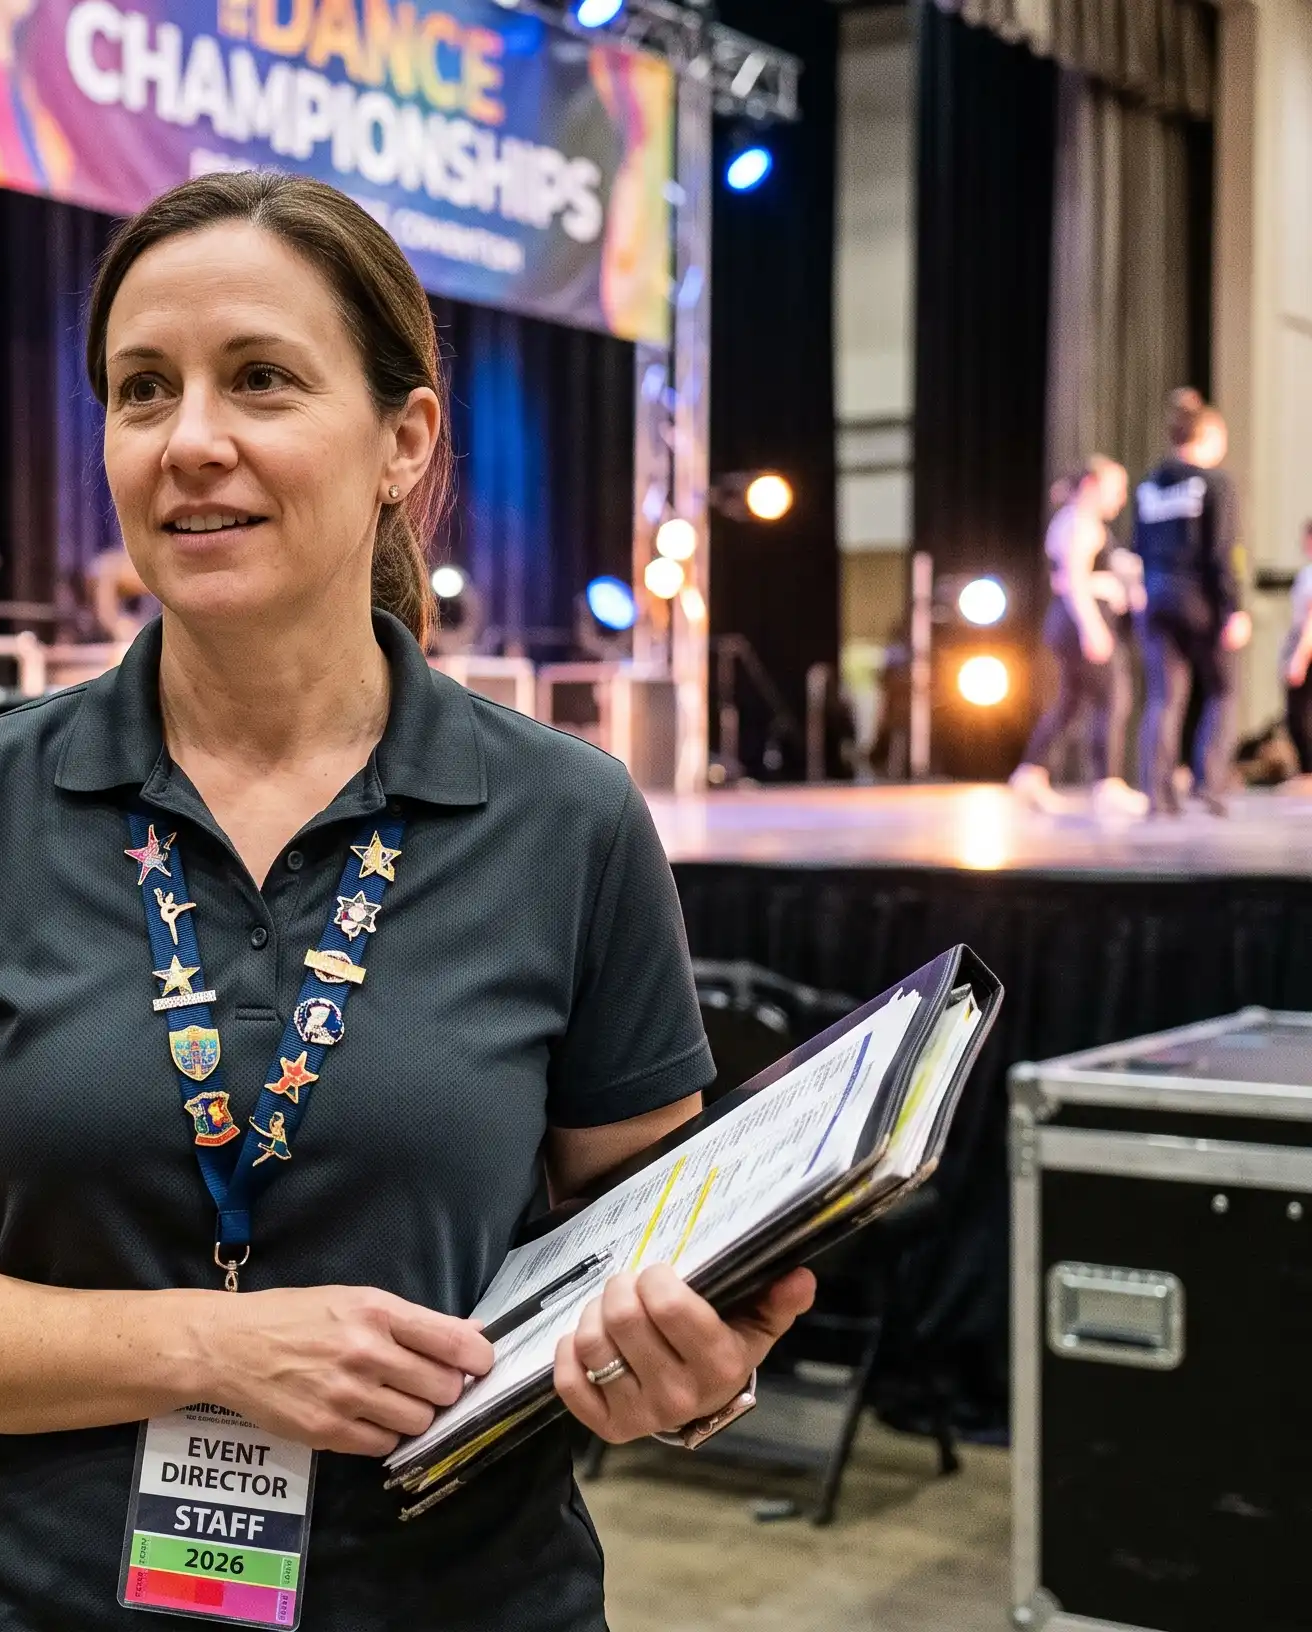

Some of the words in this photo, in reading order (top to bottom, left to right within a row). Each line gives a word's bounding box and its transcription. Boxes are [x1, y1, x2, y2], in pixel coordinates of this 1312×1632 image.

[65, 1, 603, 243] CHAMPIONSHIPS
[187, 1436, 271, 1467] EVENT
[161, 1461, 288, 1499] DIRECTOR
[173, 1504, 265, 1541] STAFF
[184, 1548, 245, 1575] 2026
